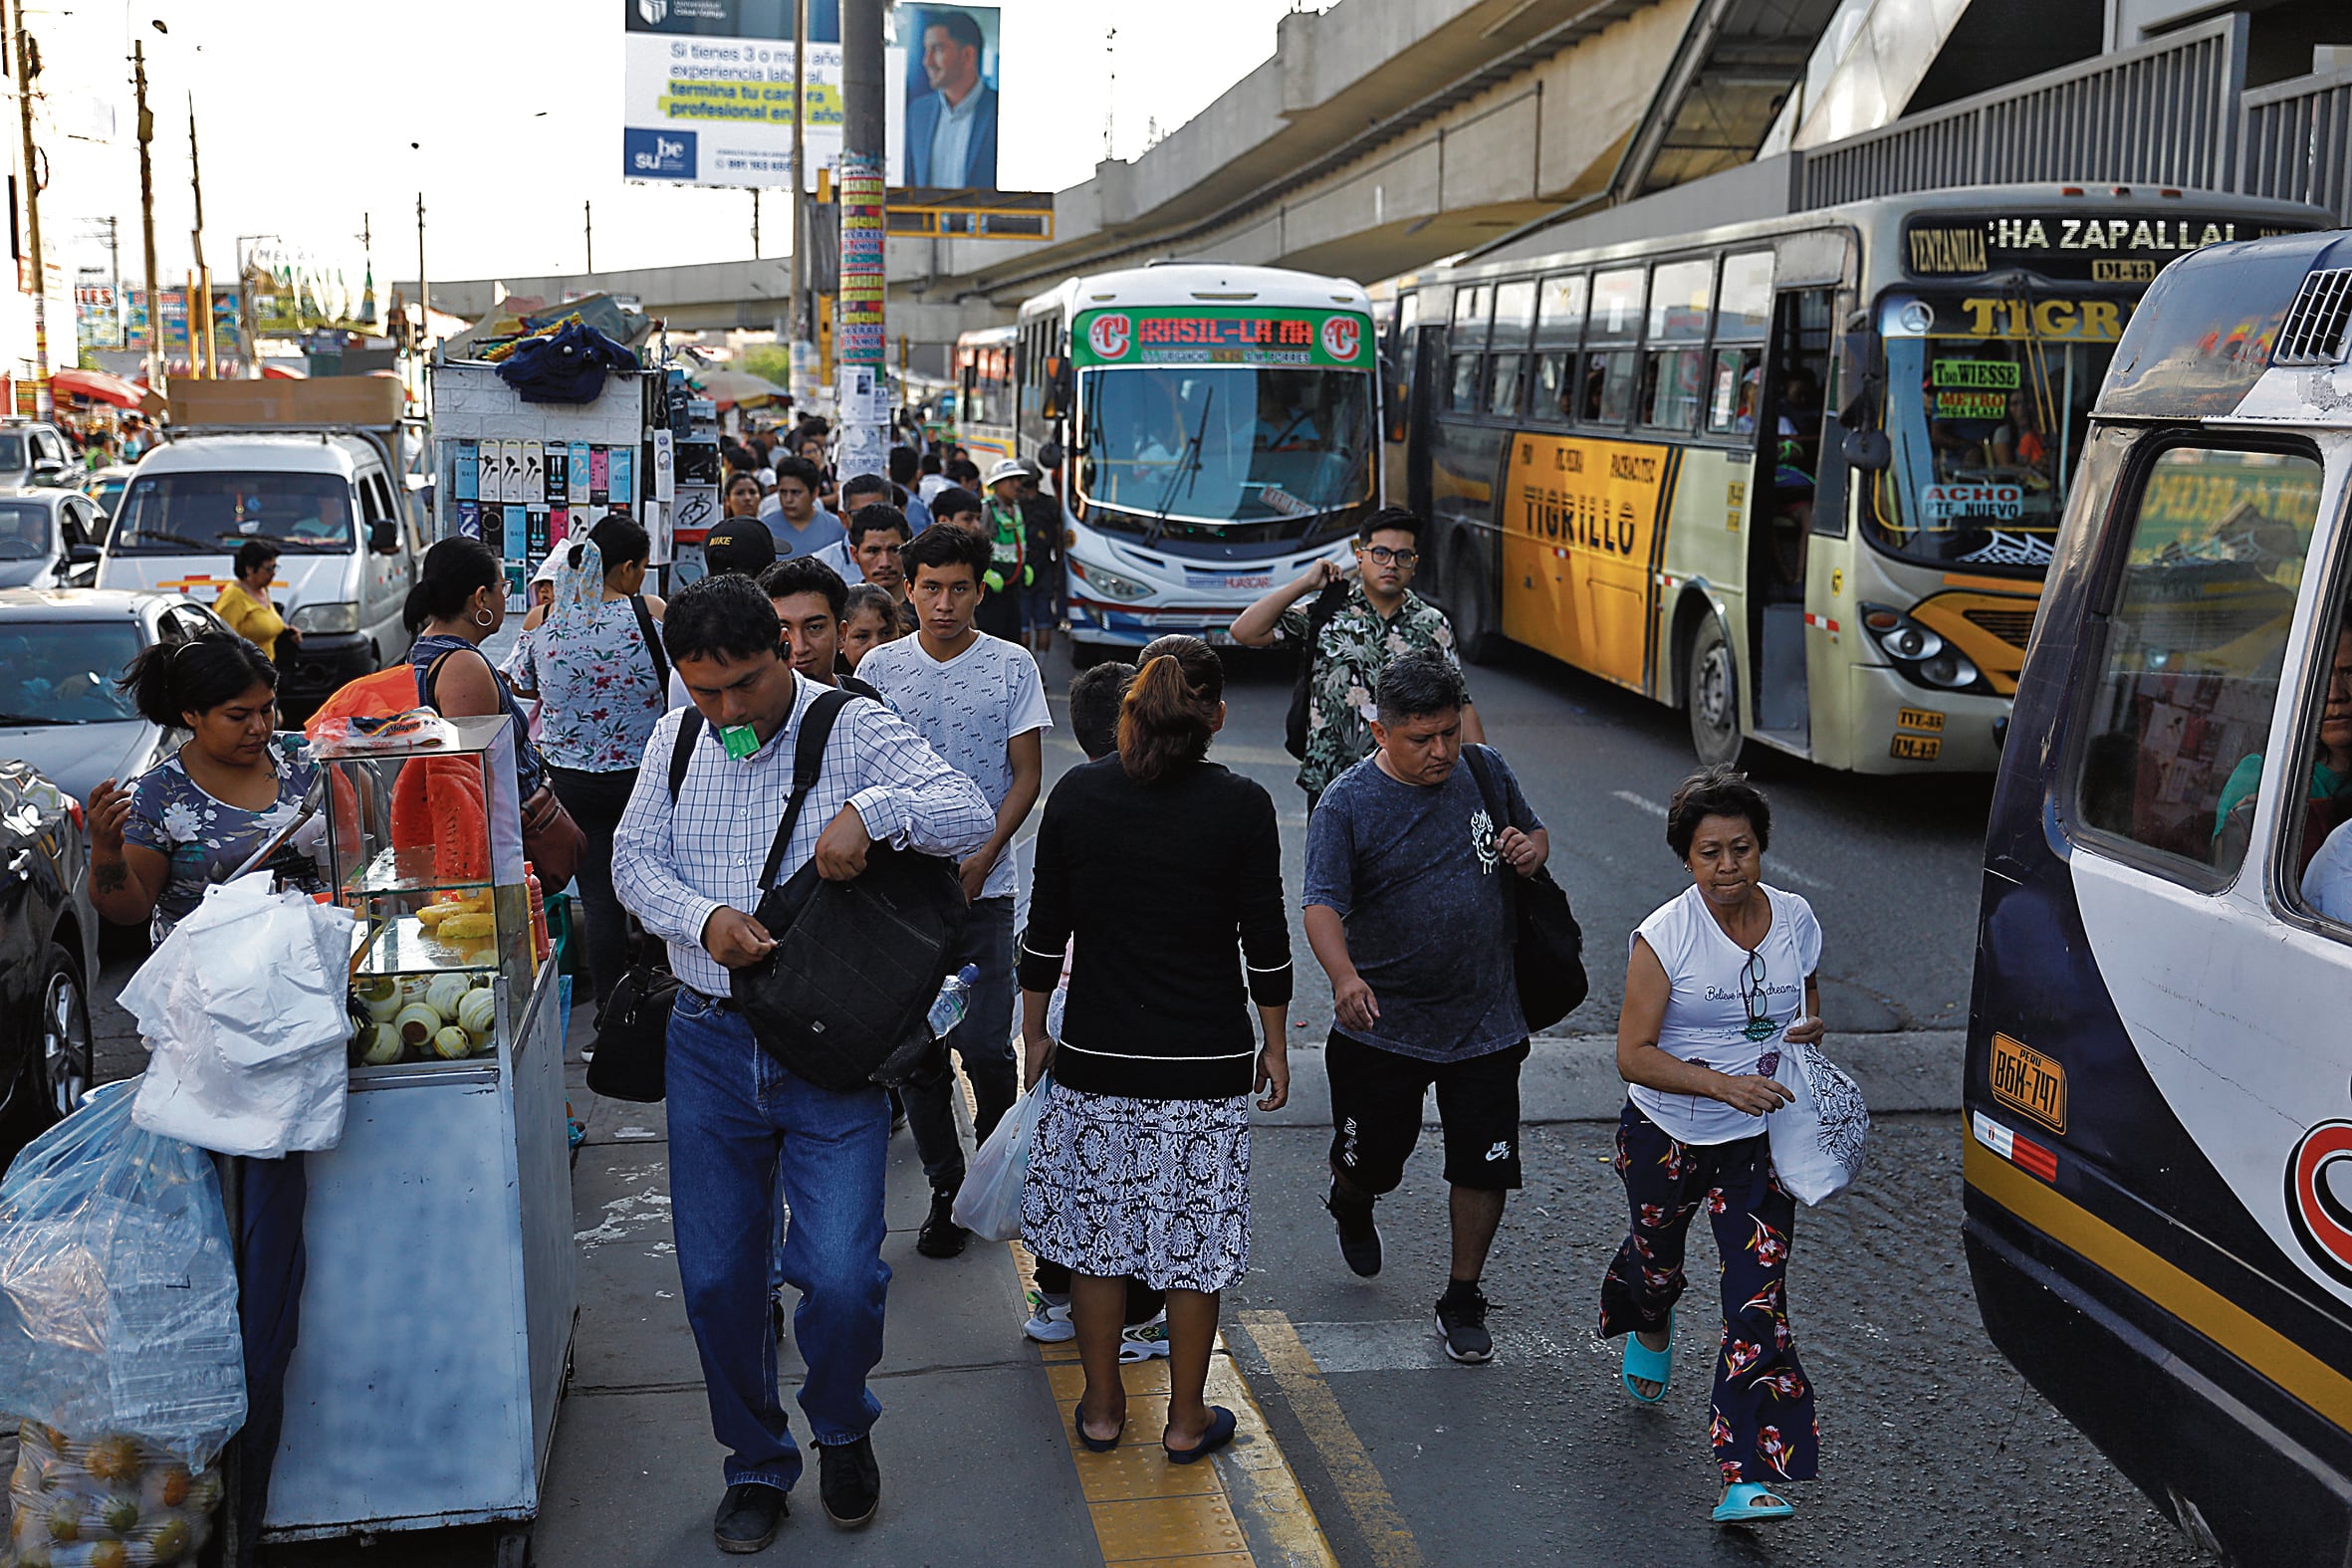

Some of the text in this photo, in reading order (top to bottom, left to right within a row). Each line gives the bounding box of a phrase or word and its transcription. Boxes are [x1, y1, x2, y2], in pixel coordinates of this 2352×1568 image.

[671, 42, 685, 58] Si
[691, 45, 739, 62] tienes
[743, 46, 755, 62] 3
[758, 51, 771, 63] o
[813, 53, 843, 67] año
[670, 65, 763, 81] experiencia
[670, 83, 737, 98] termina
[741, 86, 759, 100] tu
[670, 101, 843, 121] profesional en año
[1909, 229, 1987, 272] VENTANILLA
[1962, 299, 2138, 337] TIGR
[1958, 363, 2017, 385] WIESSE
[1940, 392, 2004, 408] METRO
[1927, 488, 2018, 502] ACHO
[1965, 503, 2019, 517] NUEVO
[1523, 484, 1635, 557] TIGRILLO
[708, 537, 734, 547] NIKE
[1705, 986, 1736, 1002] Believe
[2019, 1048, 2041, 1067] PERU
[1995, 1049, 2058, 1116] B6K-747
